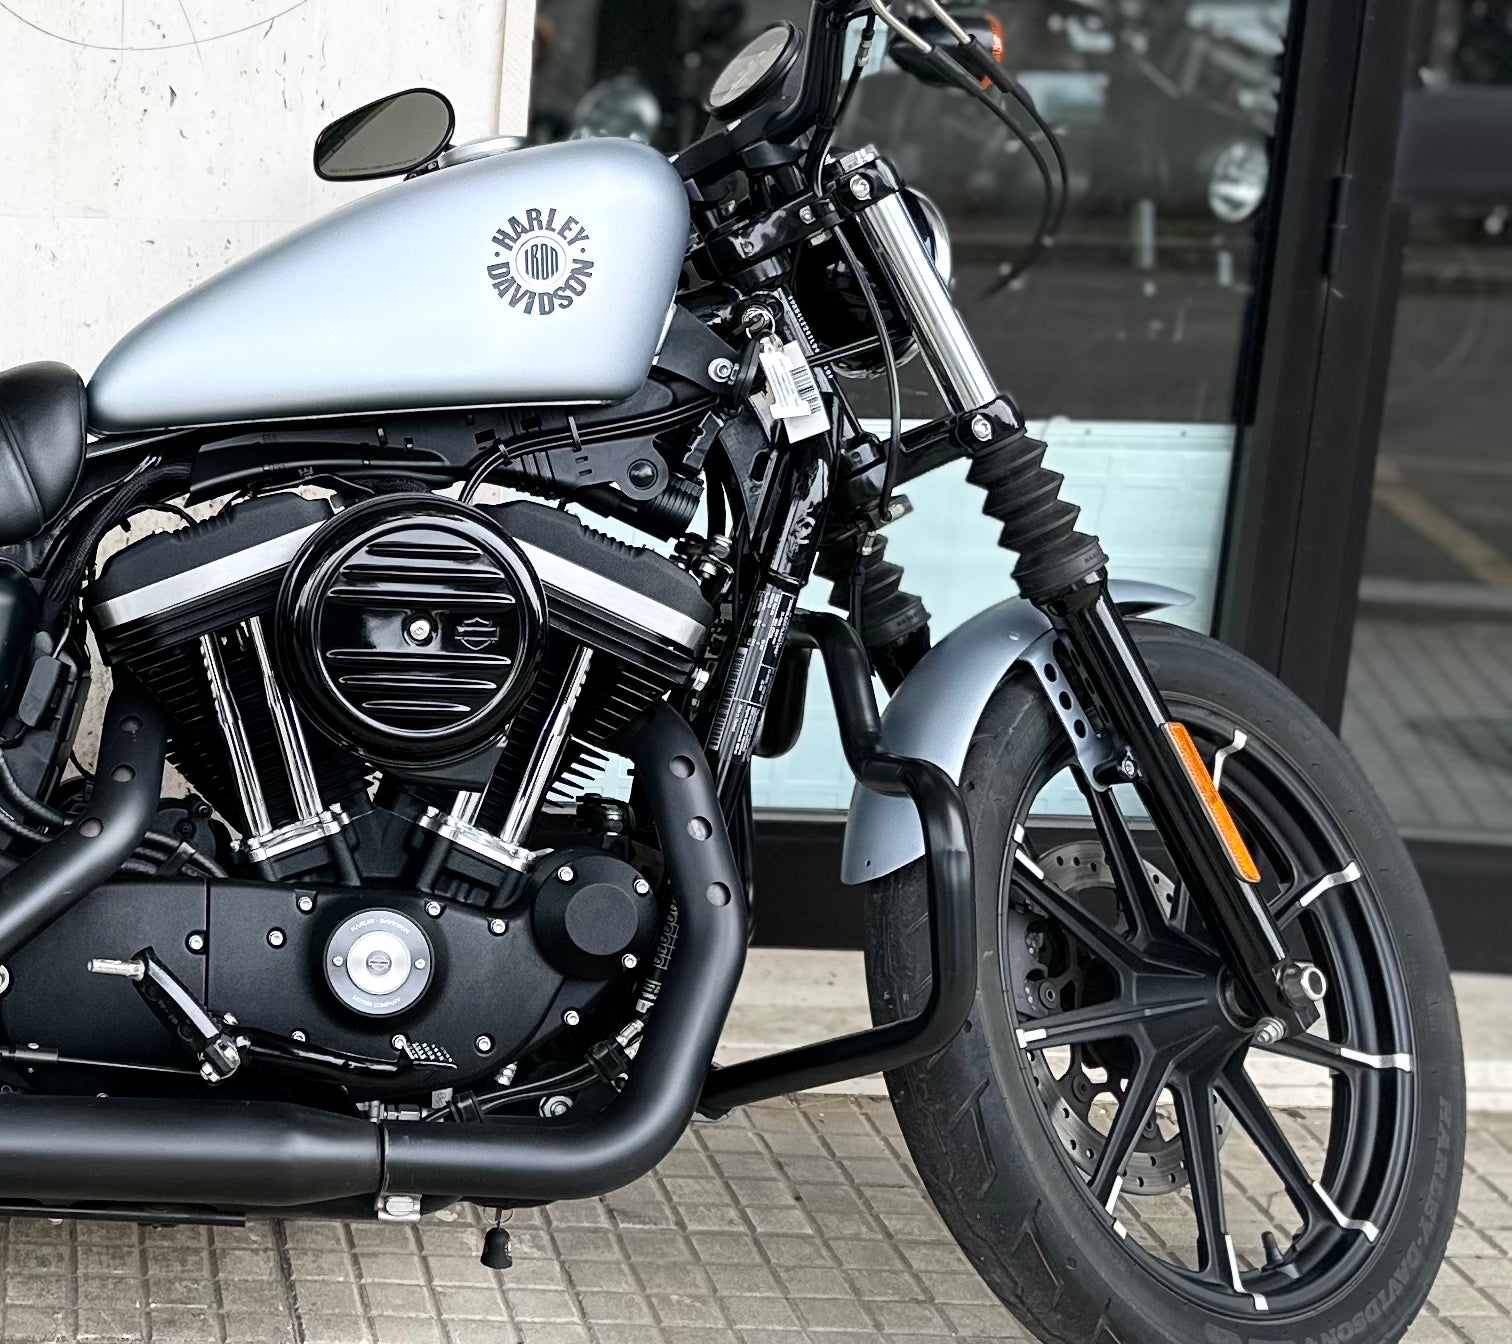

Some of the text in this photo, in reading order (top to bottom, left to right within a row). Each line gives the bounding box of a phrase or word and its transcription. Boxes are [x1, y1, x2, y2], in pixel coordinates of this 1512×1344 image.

[491, 207, 590, 252] HARLEY
[524, 243, 559, 281] IRON
[486, 258, 595, 316] DAVIDSON
